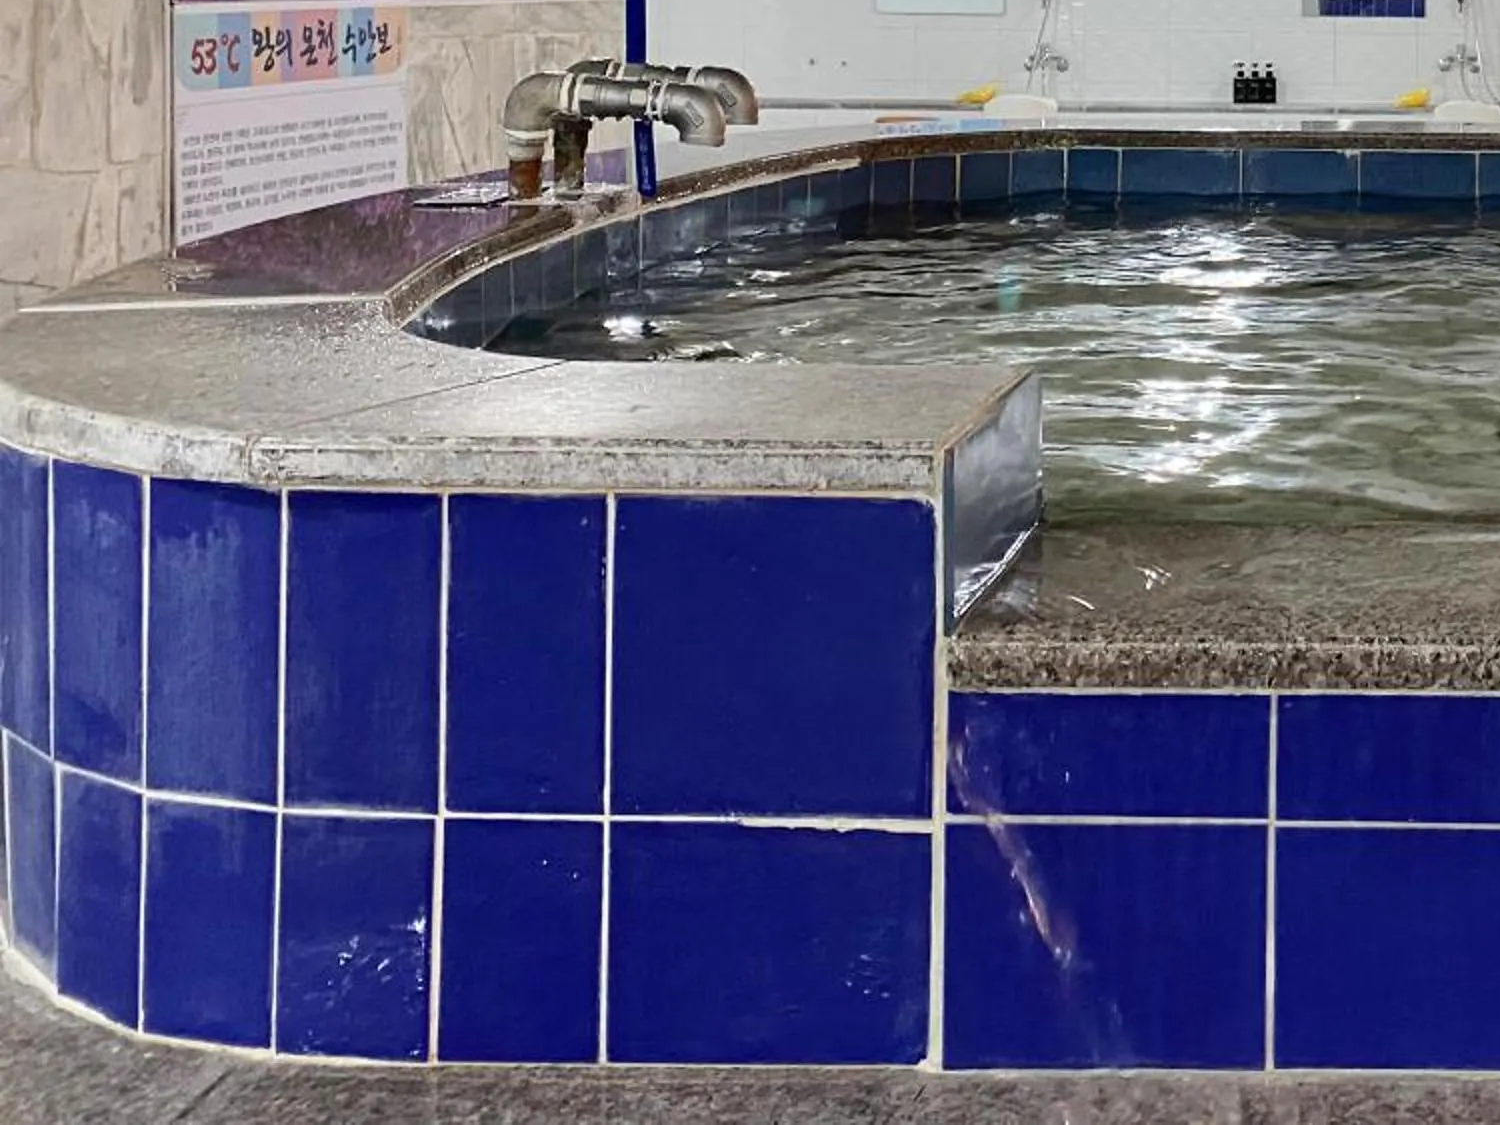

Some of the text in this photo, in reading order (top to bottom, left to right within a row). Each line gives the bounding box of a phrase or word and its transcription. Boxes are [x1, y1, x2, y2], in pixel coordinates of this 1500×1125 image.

[252, 26, 293, 71] 왕의
[300, 19, 338, 66] 온천
[342, 20, 392, 63] 수안보
